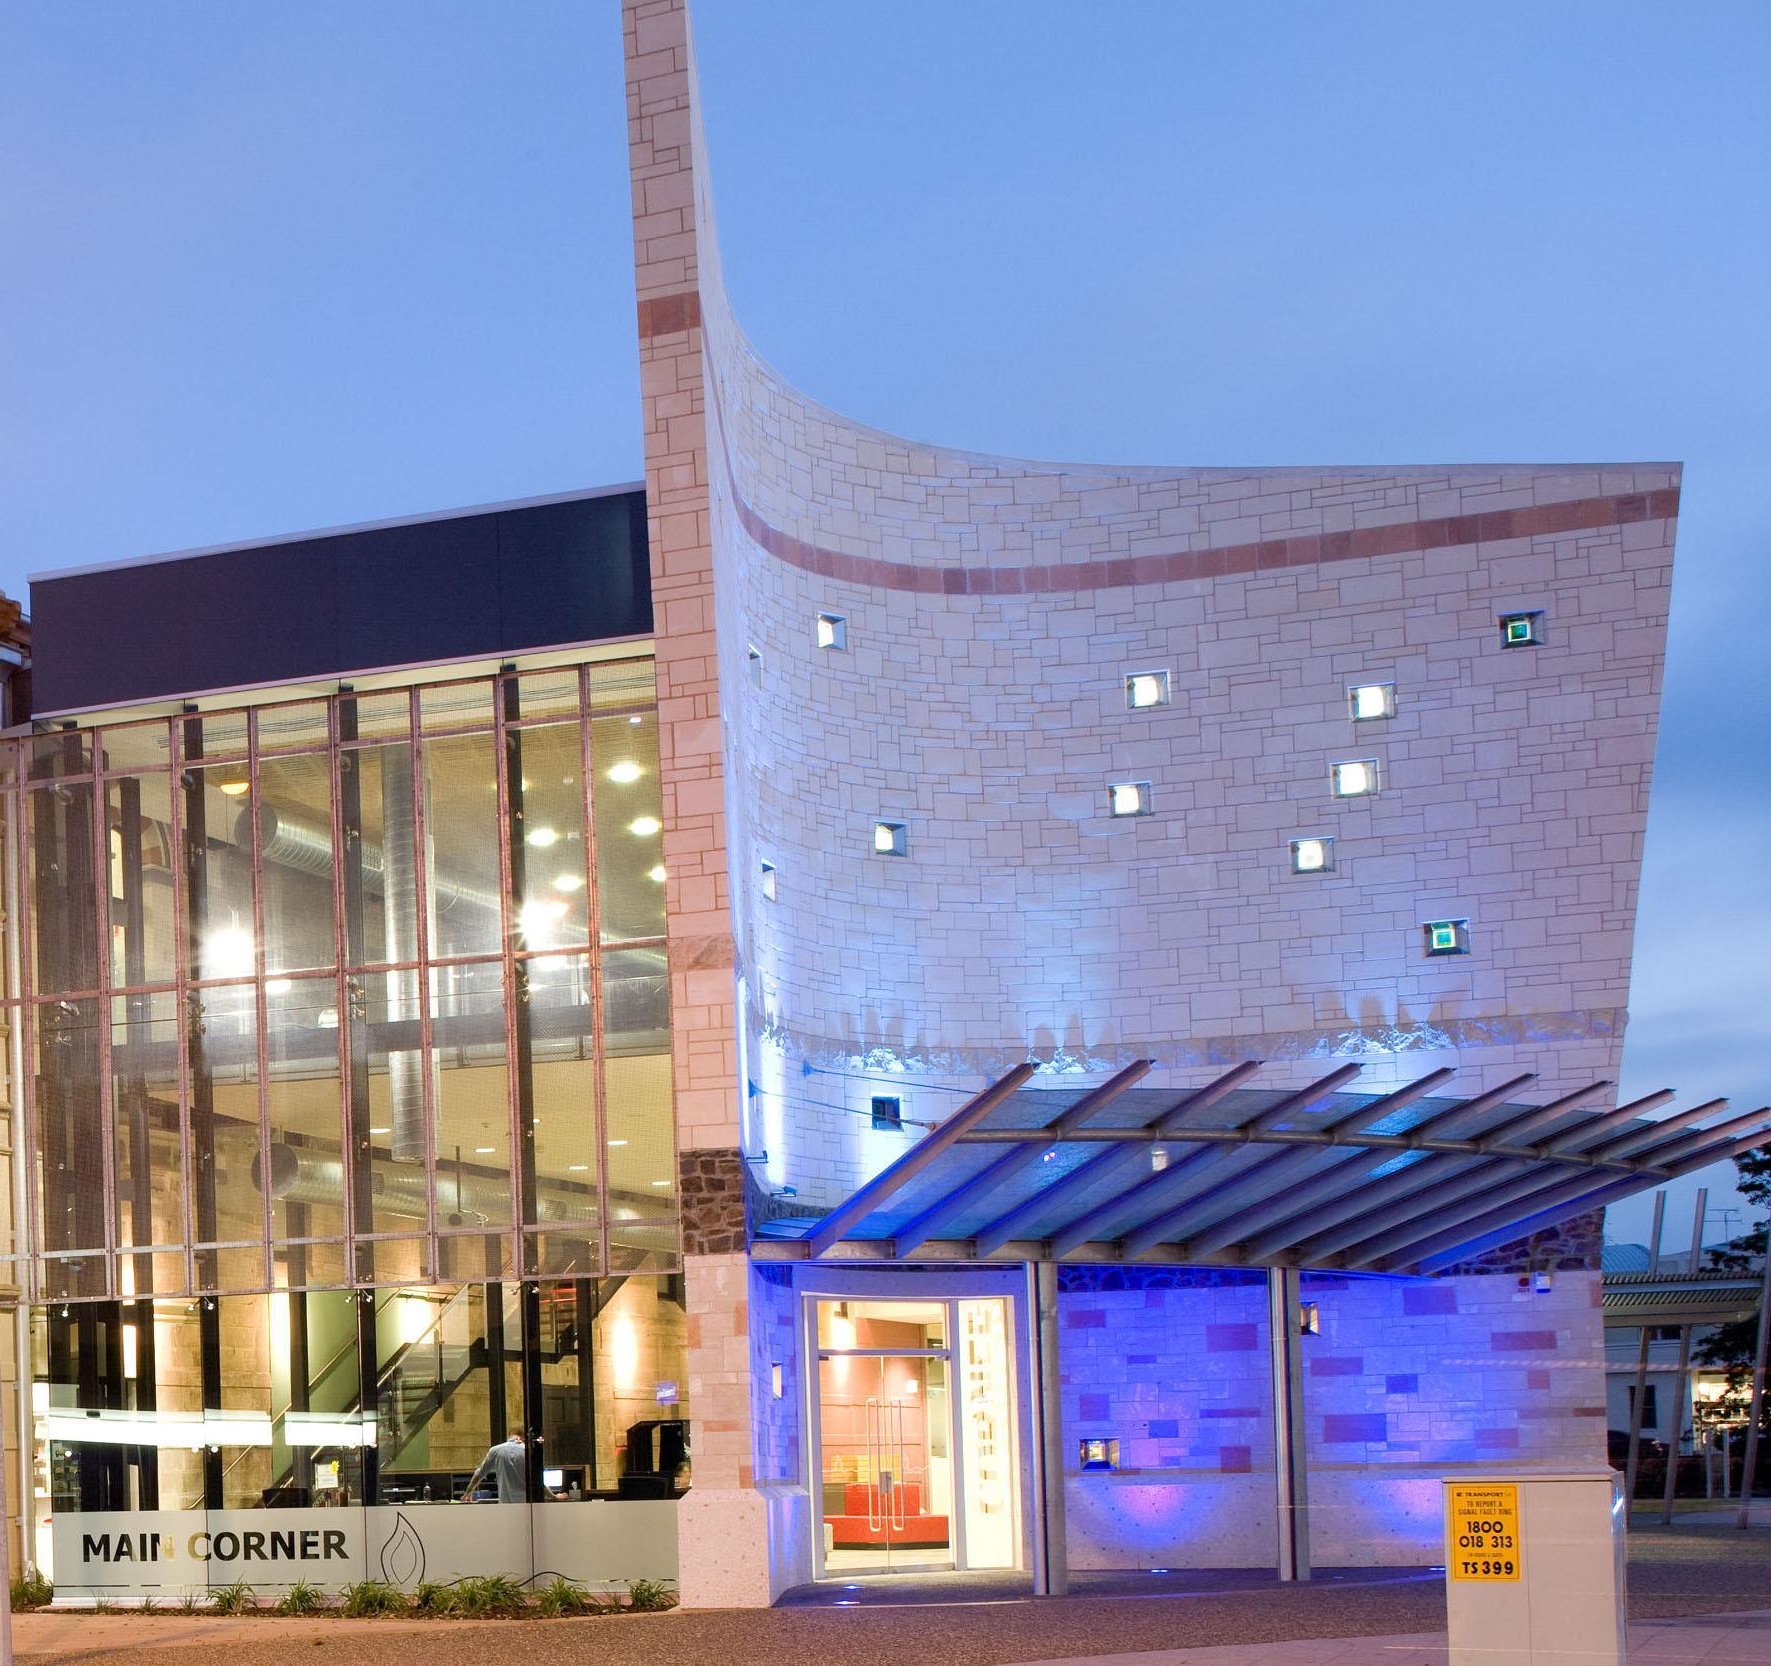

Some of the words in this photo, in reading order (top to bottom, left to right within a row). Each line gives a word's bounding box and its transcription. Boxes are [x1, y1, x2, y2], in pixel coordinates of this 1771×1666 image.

[1467, 1521, 1504, 1533] 1800
[82, 1532, 177, 1563] MAIN
[187, 1530, 349, 1562] CORNER
[1459, 1535, 1484, 1548] 018
[1491, 1535, 1513, 1548] 313
[1462, 1561, 1478, 1574] TS
[1482, 1560, 1514, 1575] 399
